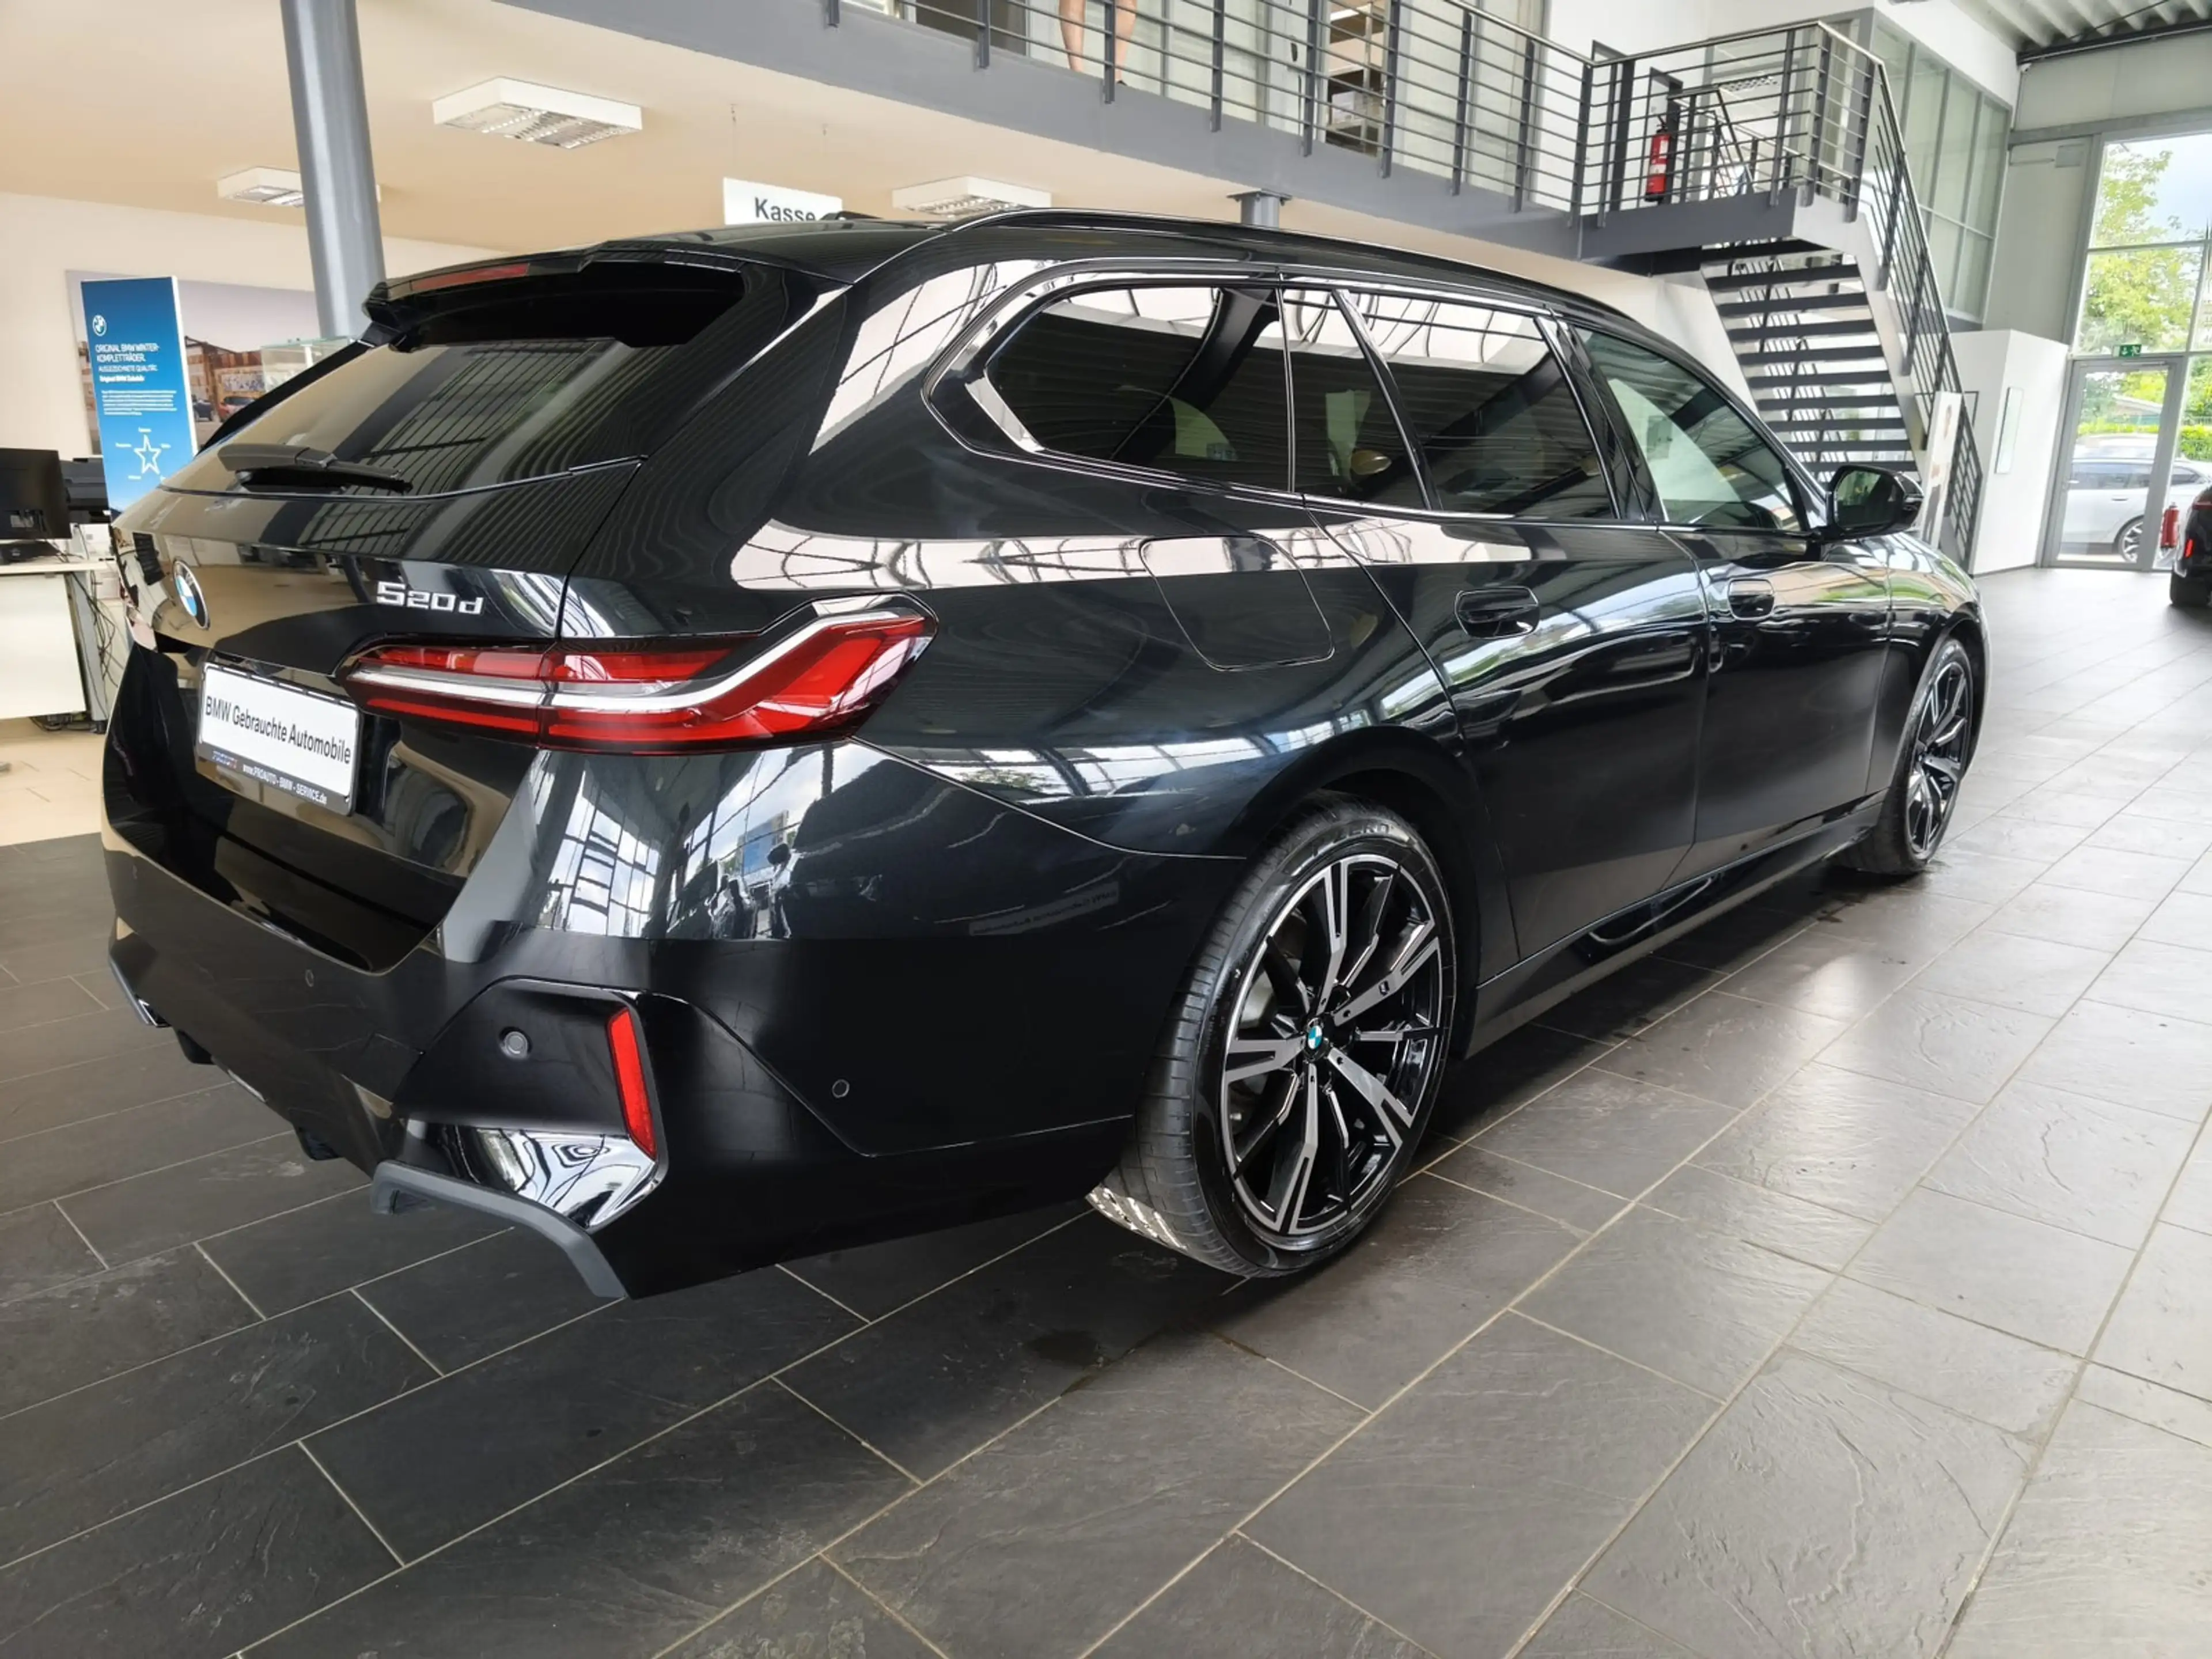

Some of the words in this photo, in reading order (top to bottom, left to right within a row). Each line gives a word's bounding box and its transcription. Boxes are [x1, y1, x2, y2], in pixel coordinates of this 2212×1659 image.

[755, 197, 816, 222] Kasse
[376, 581, 483, 615] 520d
[206, 696, 232, 722] BMW
[232, 705, 287, 742] Gebrauchte
[289, 724, 351, 764] Automobile
